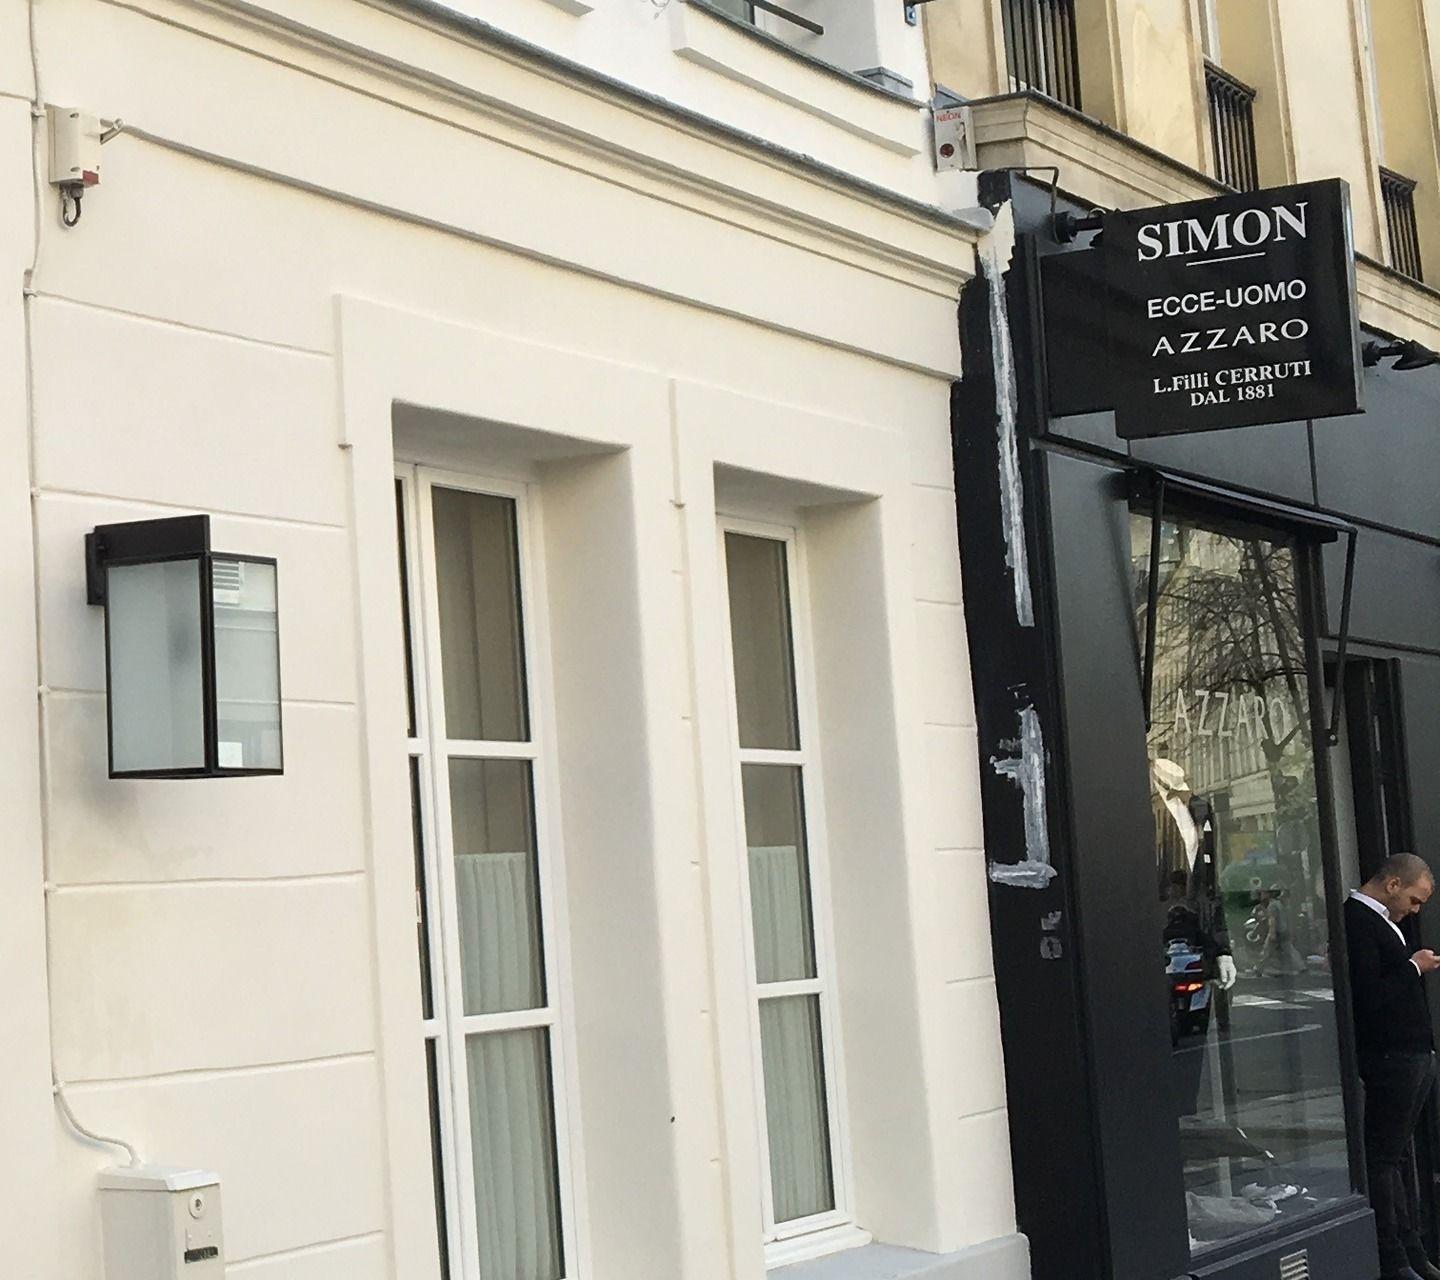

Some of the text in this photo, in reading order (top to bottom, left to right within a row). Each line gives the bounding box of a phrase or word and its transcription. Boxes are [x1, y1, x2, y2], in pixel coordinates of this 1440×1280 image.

[1137, 202, 1309, 262] SIMON
[1147, 279, 1307, 319] ECCE-UOMO
[1151, 318, 1309, 357] AZZARO
[1153, 360, 1312, 394] L.Filli CERRUTI
[1190, 383, 1274, 407] DAL 1881
[1173, 687, 1289, 746] AZZARO
